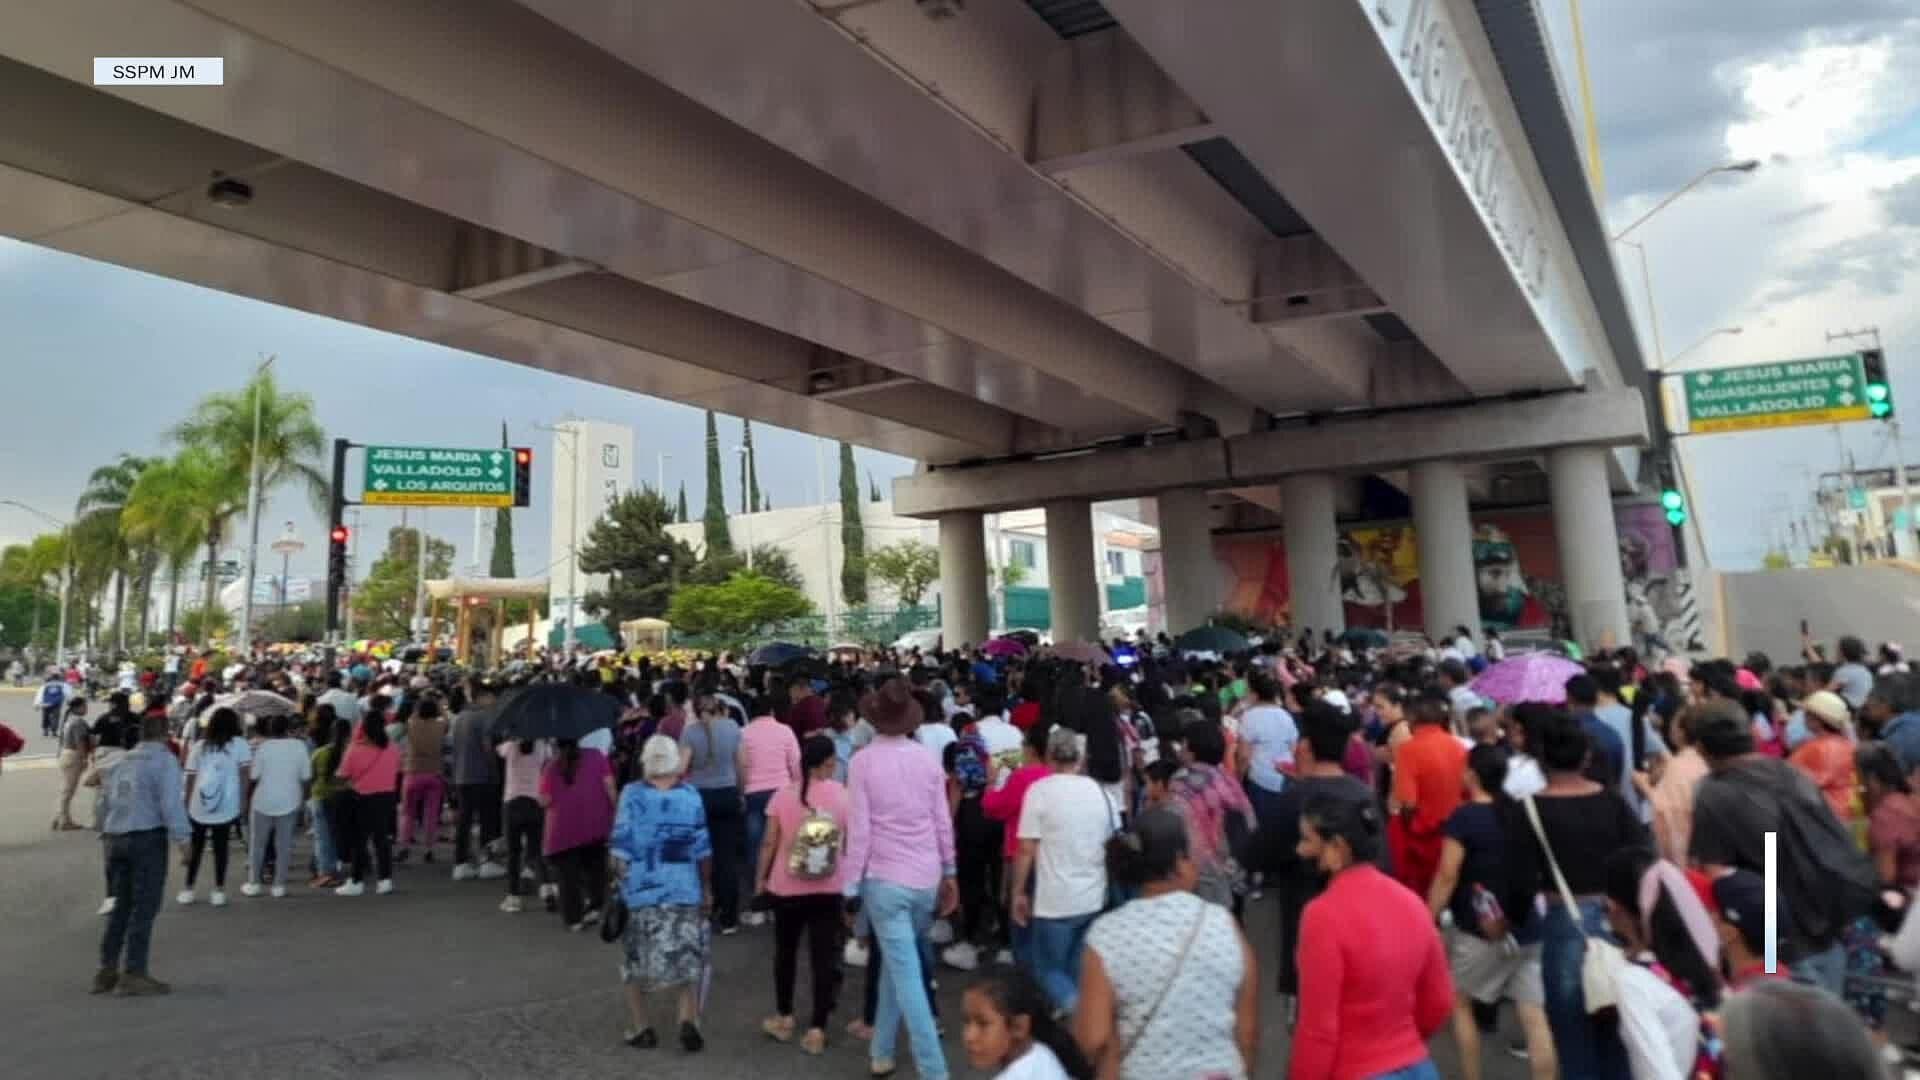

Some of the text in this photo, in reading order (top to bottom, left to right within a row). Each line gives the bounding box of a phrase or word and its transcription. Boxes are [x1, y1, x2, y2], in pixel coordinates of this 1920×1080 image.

[1719, 359, 1851, 383] JESUS MARIA
[1695, 395, 1826, 417] VALLADOLID
[372, 449, 482, 462] JESUS MARIA
[371, 464, 482, 477] VALLADOLID
[396, 480, 506, 492] LOS ARQUITOS
